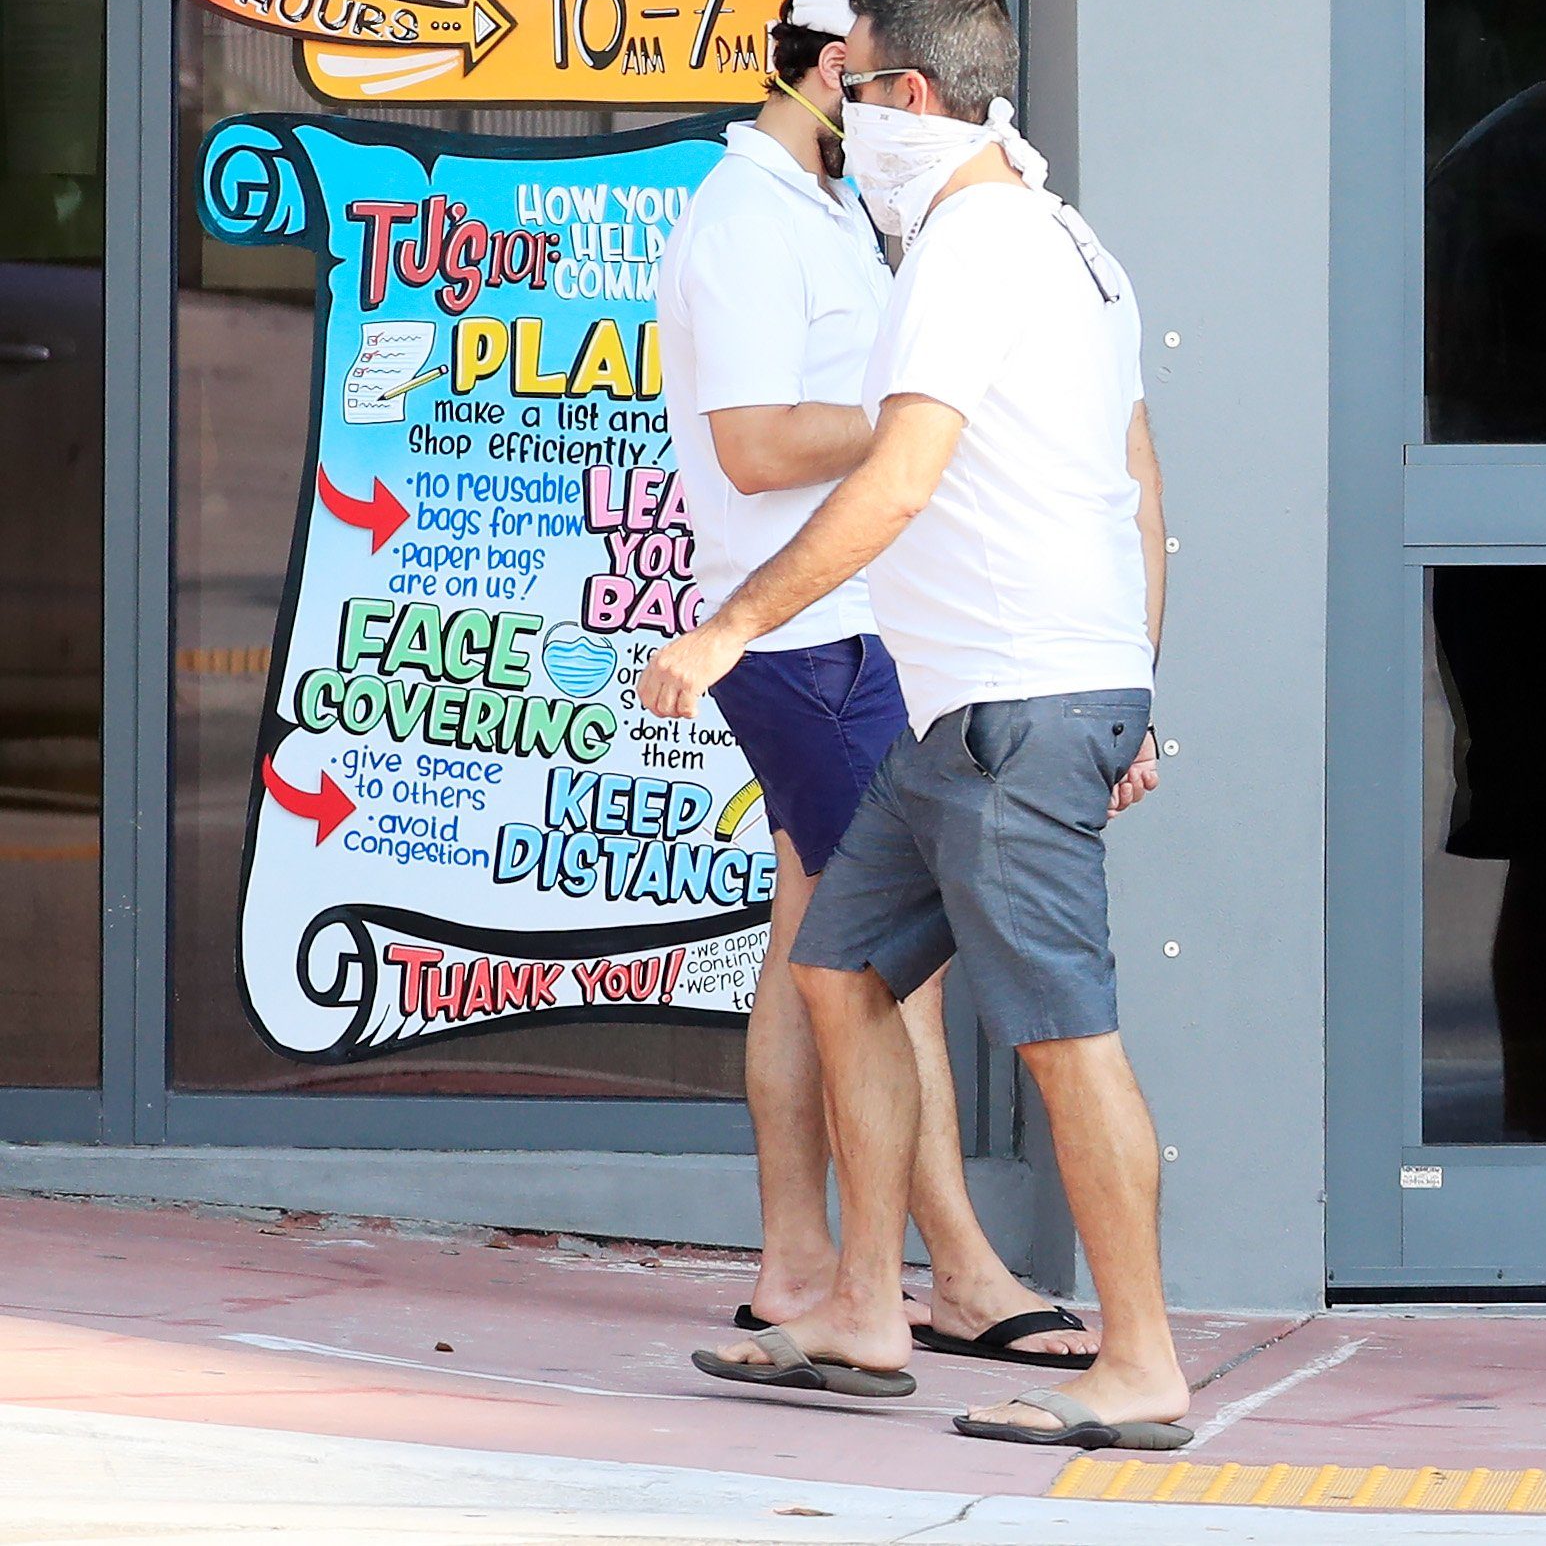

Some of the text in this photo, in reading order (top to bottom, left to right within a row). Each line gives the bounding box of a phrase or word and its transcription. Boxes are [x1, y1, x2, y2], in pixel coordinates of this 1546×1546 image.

[517, 183, 611, 227] HOW
[434, 398, 504, 425] make
[521, 406, 541, 429] a
[609, 407, 668, 434] and
[414, 471, 580, 505] no reusable
[417, 504, 584, 539] bags for now
[488, 544, 546, 575] bags
[389, 572, 445, 596] are
[451, 574, 481, 597] on
[336, 595, 543, 690] FACE
[296, 668, 618, 764] COVERING
[630, 717, 681, 744] don't
[343, 749, 503, 791] give space
[641, 742, 704, 770] them
[357, 774, 385, 801] to
[545, 766, 713, 840] KEEP
[379, 814, 459, 842] avoid
[492, 823, 778, 907] DISTANCE
[697, 941, 719, 958] we
[385, 943, 686, 1021] THANK YOU!
[687, 970, 745, 994] we're
